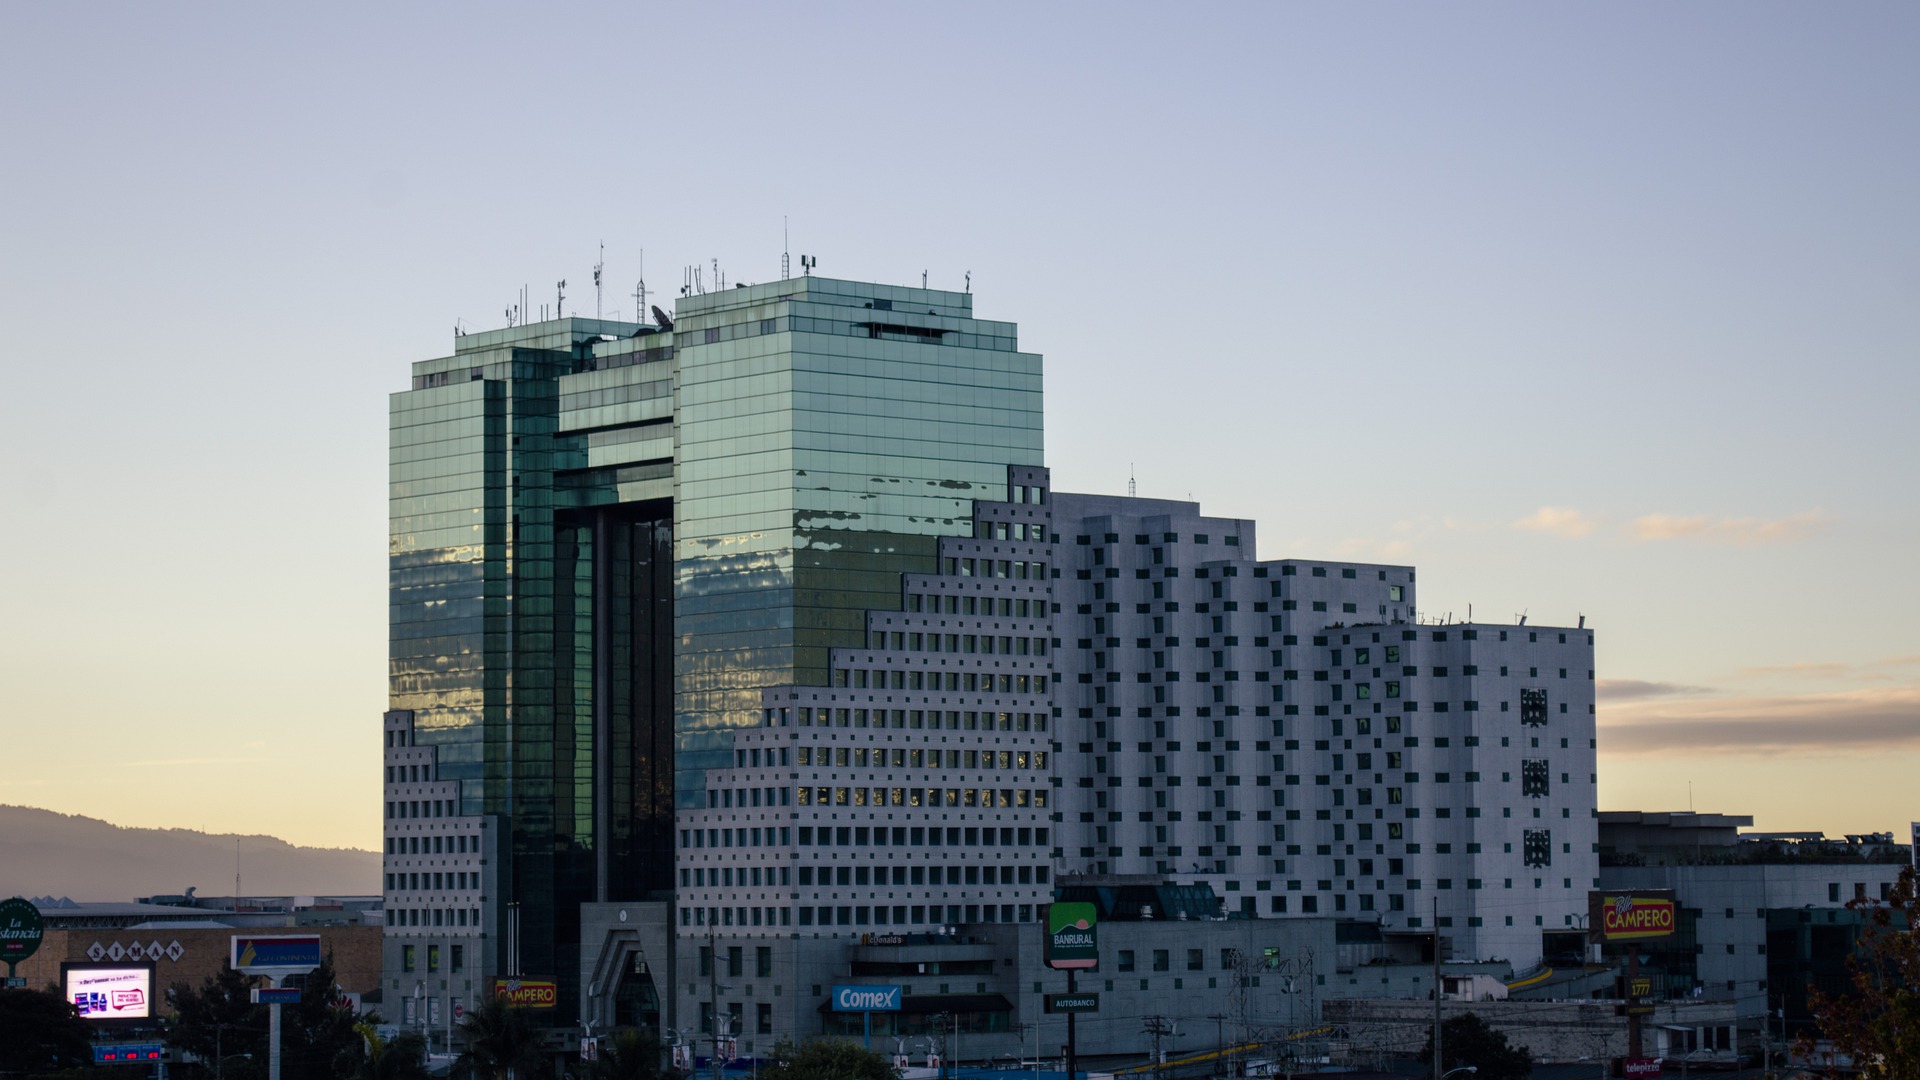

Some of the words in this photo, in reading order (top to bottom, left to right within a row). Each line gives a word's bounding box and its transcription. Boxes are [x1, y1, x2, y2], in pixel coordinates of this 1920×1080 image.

[1613, 895, 1633, 914] Pollo
[9, 918, 22, 928] La
[1606, 909, 1672, 928] CAMPERO
[0, 927, 41, 939] stancia
[862, 933, 902, 945] McDonald's
[1054, 934, 1094, 945] BANRURAL
[93, 946, 180, 958] SIMAN
[498, 988, 554, 1002] CAMPERO
[1631, 984, 1650, 996] 1777
[840, 987, 898, 1008] Comex
[1056, 999, 1095, 1008] AUTOBANCO
[1626, 1063, 1660, 1075] telepizza
